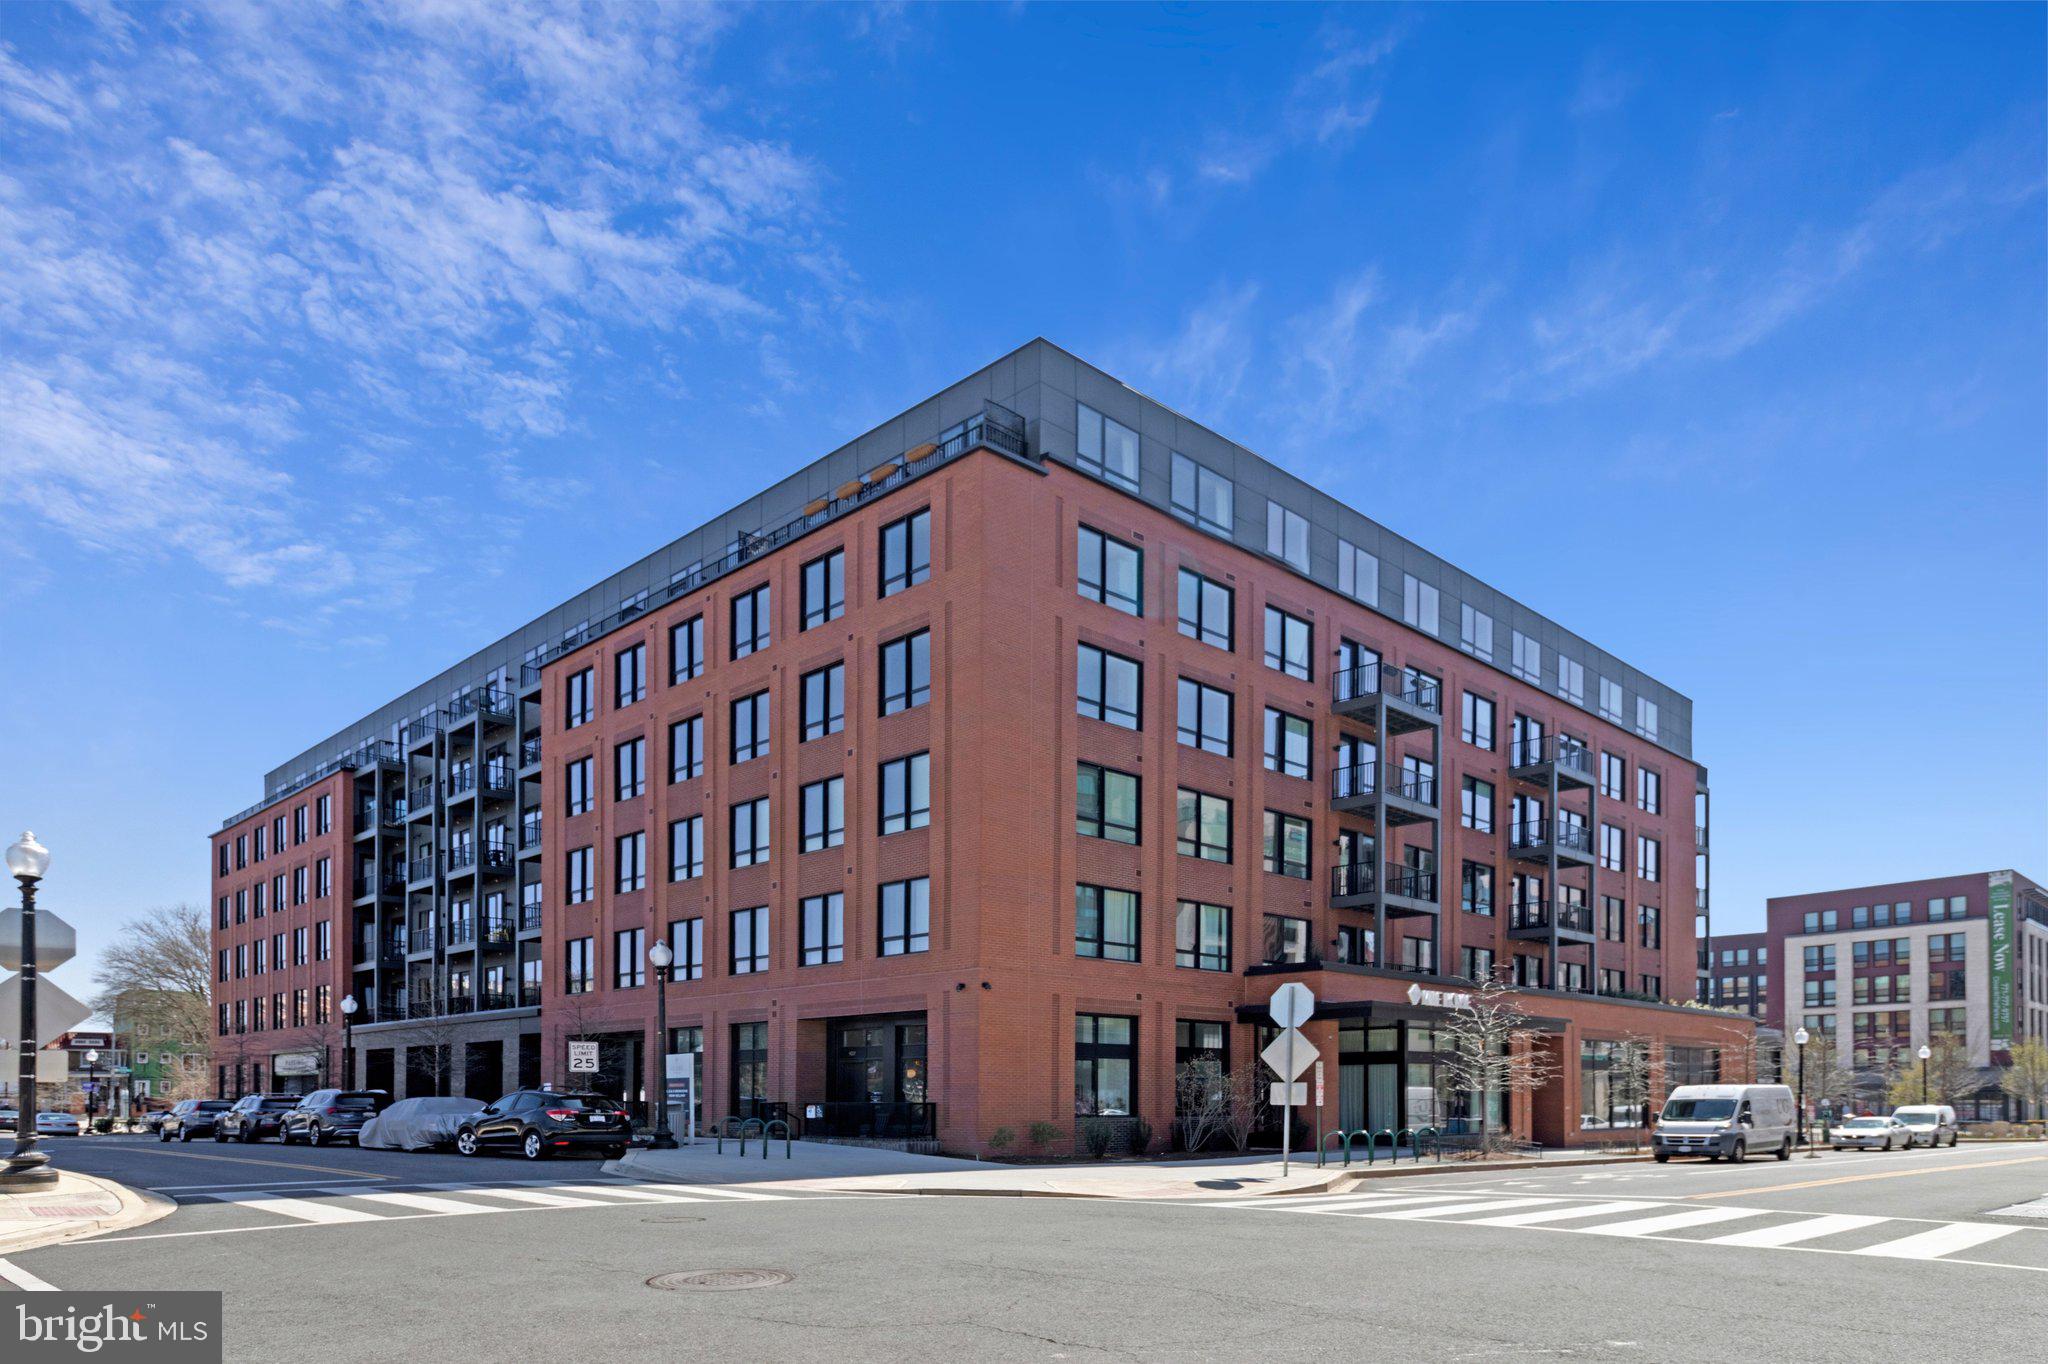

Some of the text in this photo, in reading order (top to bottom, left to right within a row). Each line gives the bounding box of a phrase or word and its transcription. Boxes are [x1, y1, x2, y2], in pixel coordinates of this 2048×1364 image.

[1993, 903, 2010, 940] Lease
[1993, 943, 2010, 972] Now
[574, 1058, 595, 1068] 25
